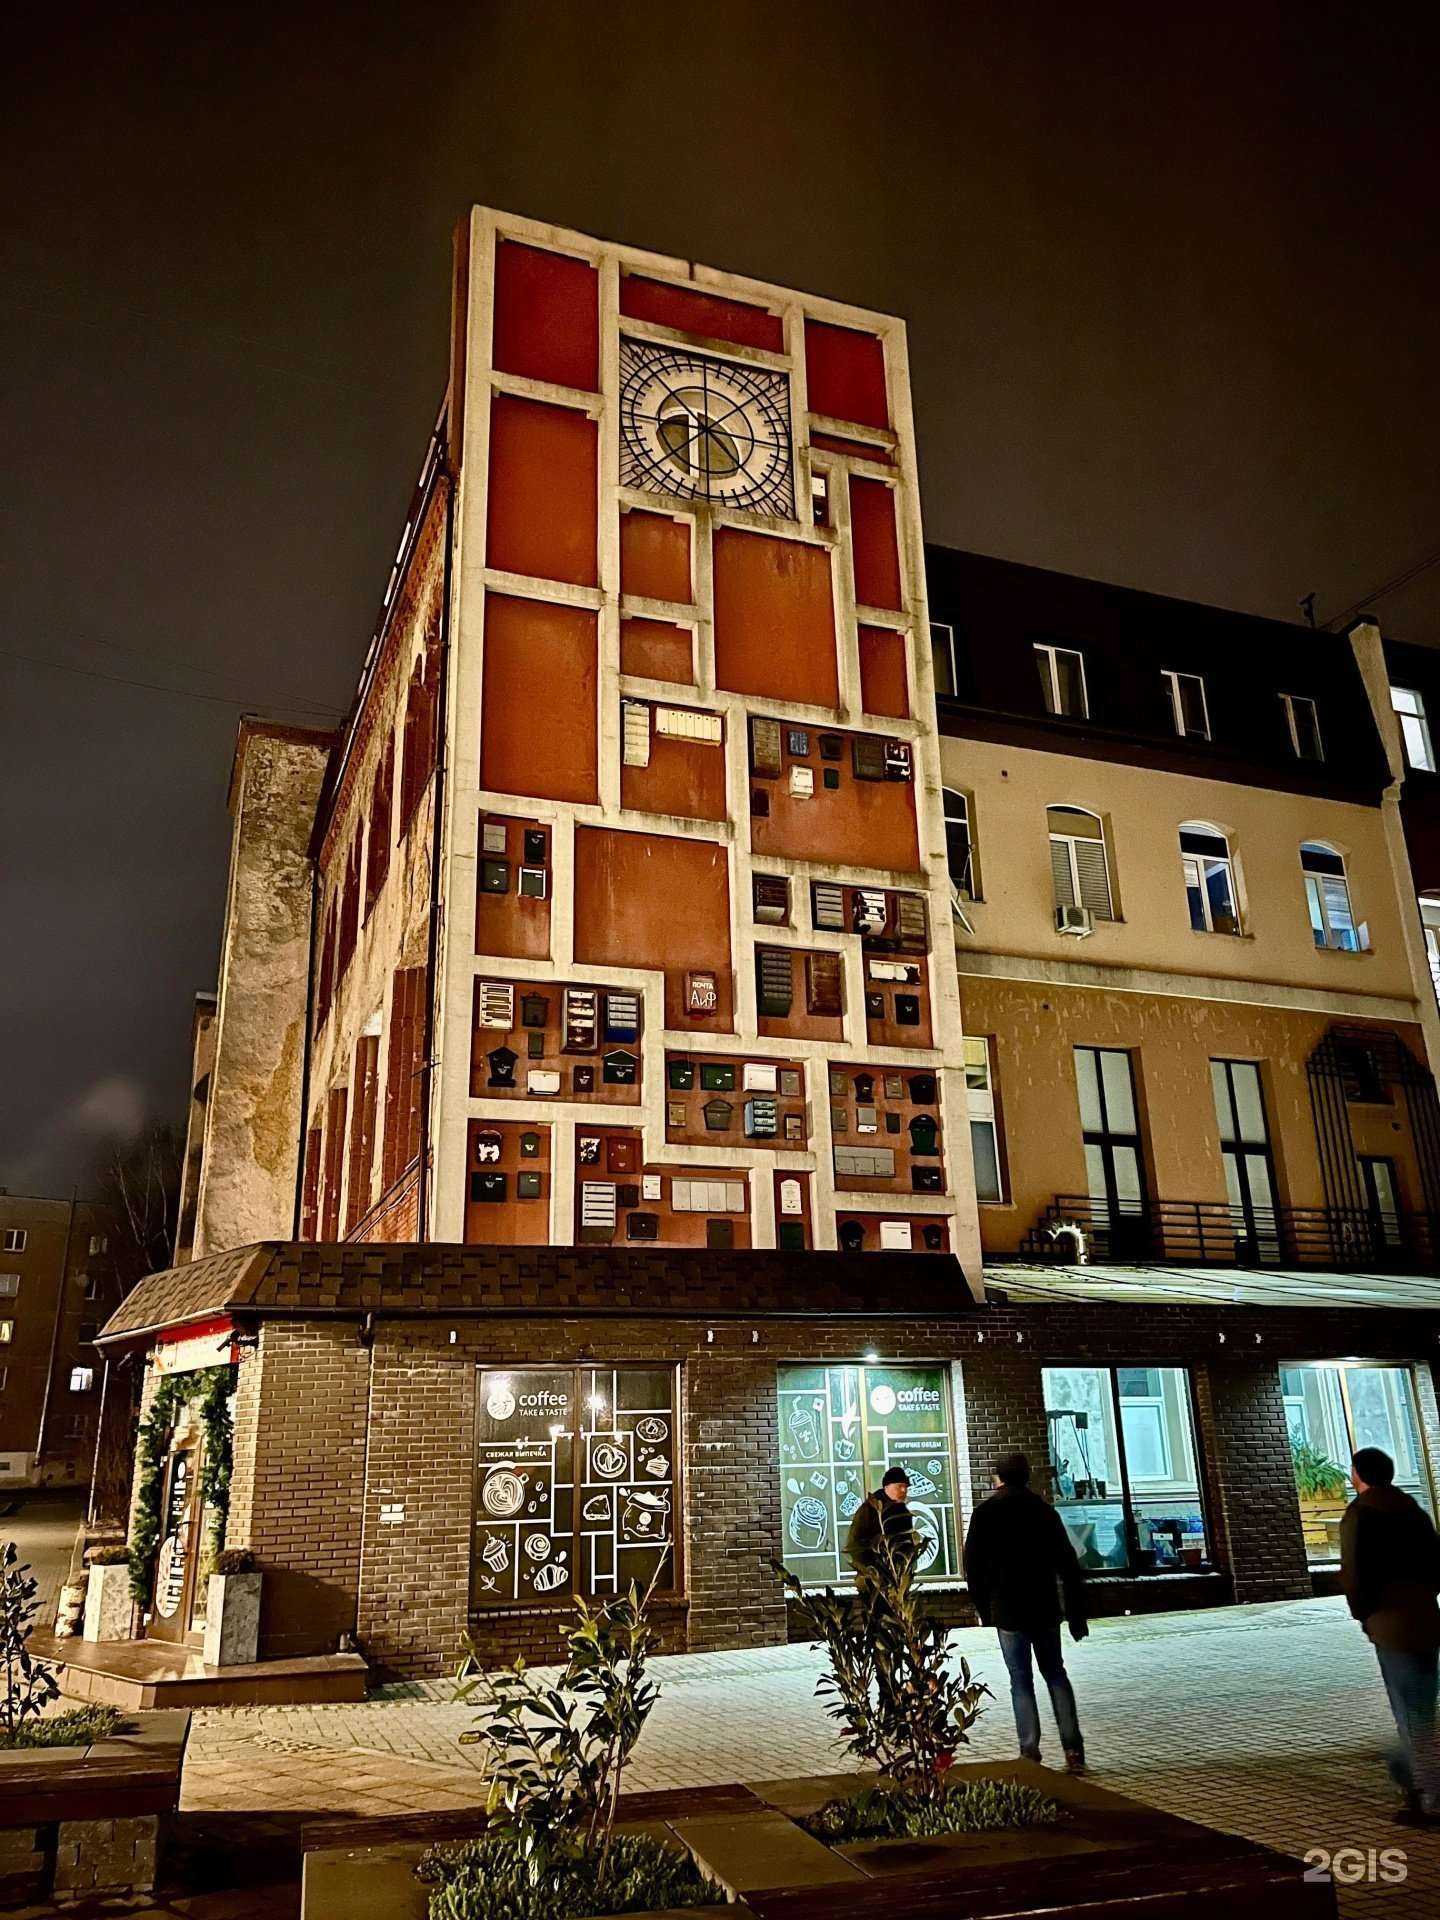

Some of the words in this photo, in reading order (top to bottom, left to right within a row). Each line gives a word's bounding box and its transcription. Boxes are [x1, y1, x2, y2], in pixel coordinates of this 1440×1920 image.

[692, 981, 714, 990] ПОЧТА
[691, 990, 717, 1007] АиФ
[519, 1391, 568, 1406] coffee
[897, 1387, 939, 1402] coffee
[545, 1408, 568, 1416] TASTE
